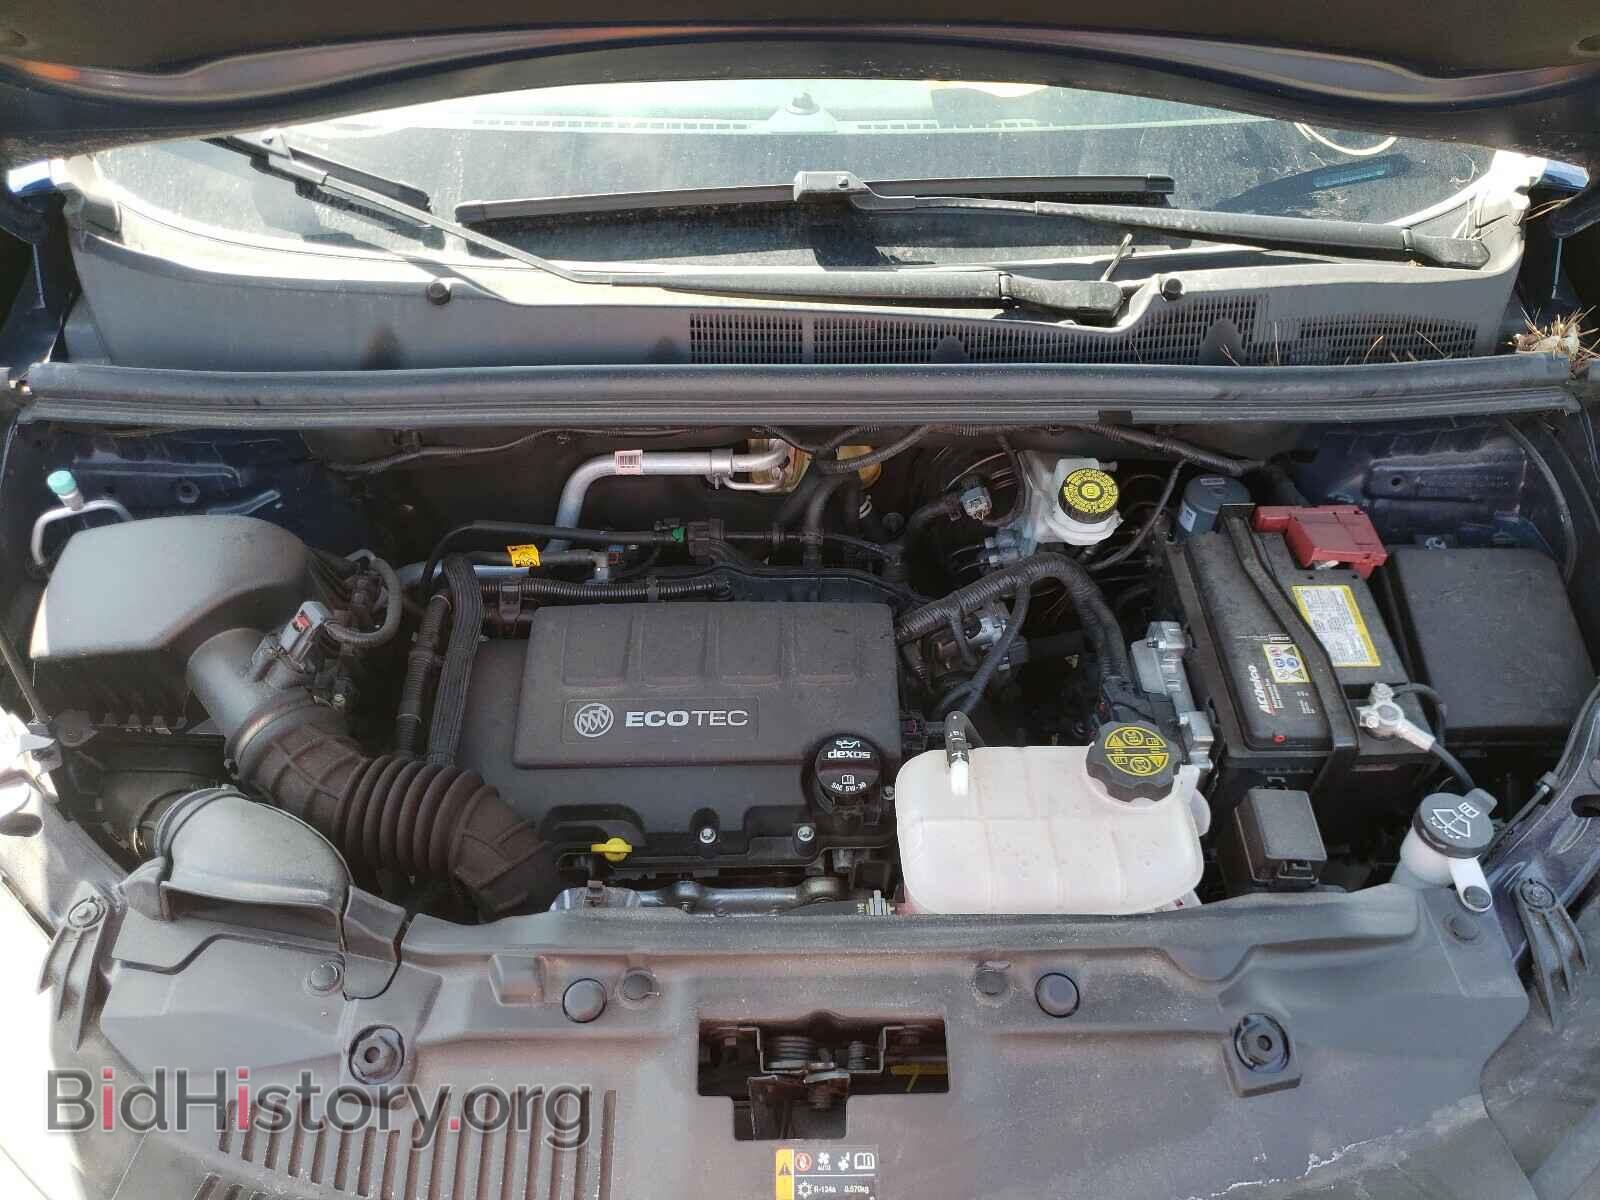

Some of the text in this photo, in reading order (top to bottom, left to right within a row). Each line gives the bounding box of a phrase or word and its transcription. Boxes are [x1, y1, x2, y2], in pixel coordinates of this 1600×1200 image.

[1247, 665, 1272, 715] ACDelco
[625, 710, 749, 728] ECOTEC
[827, 749, 871, 759] dexos
